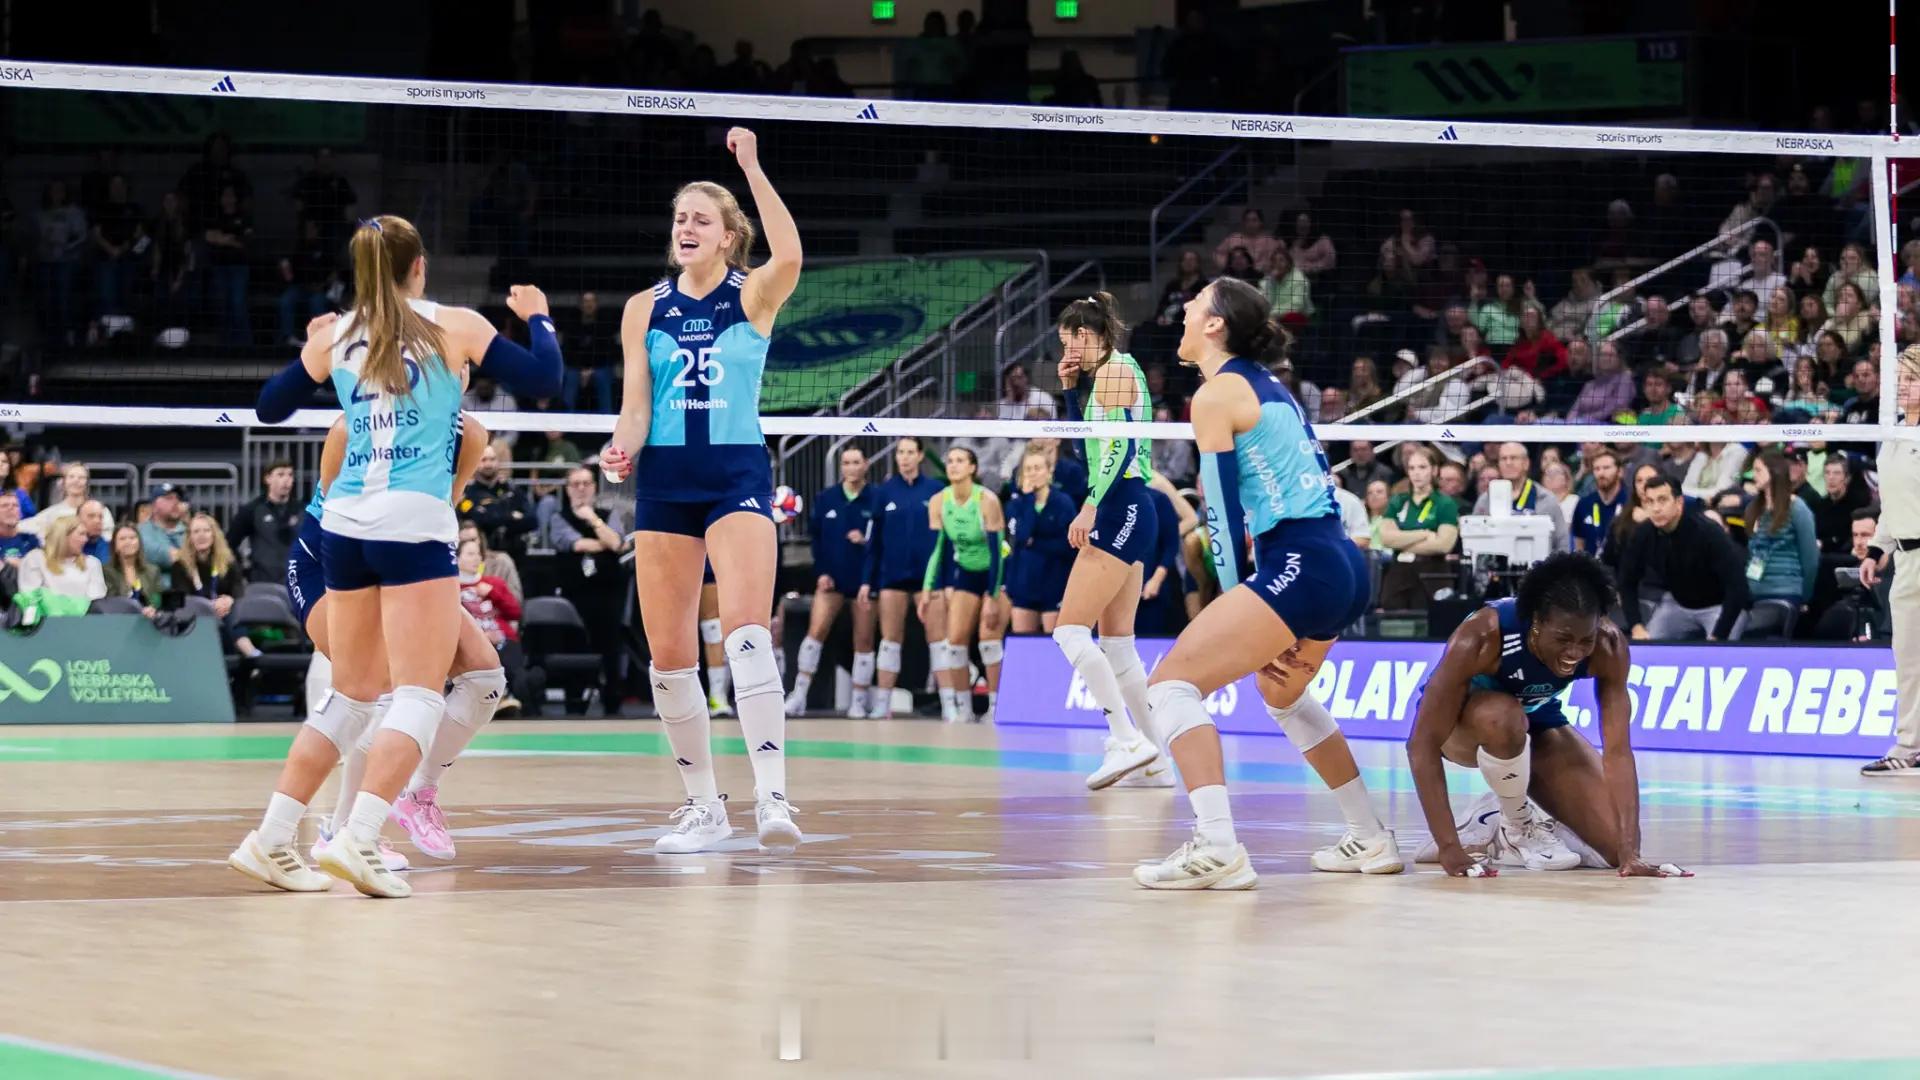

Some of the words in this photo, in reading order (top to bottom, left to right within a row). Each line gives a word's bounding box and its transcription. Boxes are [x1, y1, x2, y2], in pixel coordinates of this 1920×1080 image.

[406, 87, 441, 99] sports
[443, 88, 486, 101] imports
[627, 95, 696, 110] NEBRASKA
[1031, 112, 1064, 124] sports
[1065, 114, 1104, 126] imports
[1231, 119, 1294, 133] NEBRASKA
[1596, 133, 1626, 144] sports
[1776, 137, 1834, 151] NEBRASKA
[678, 333, 714, 342] MADISON
[669, 347, 725, 387] 25
[353, 409, 419, 434] GRIMES
[1111, 503, 1139, 550] NEBRASKA
[1207, 506, 1226, 568] LOVB
[66, 659, 111, 673] LOVB
[68, 673, 155, 687] NEBRASKA
[71, 687, 172, 702] VOLLEYBALL
[1308, 659, 1428, 721] PLAY
